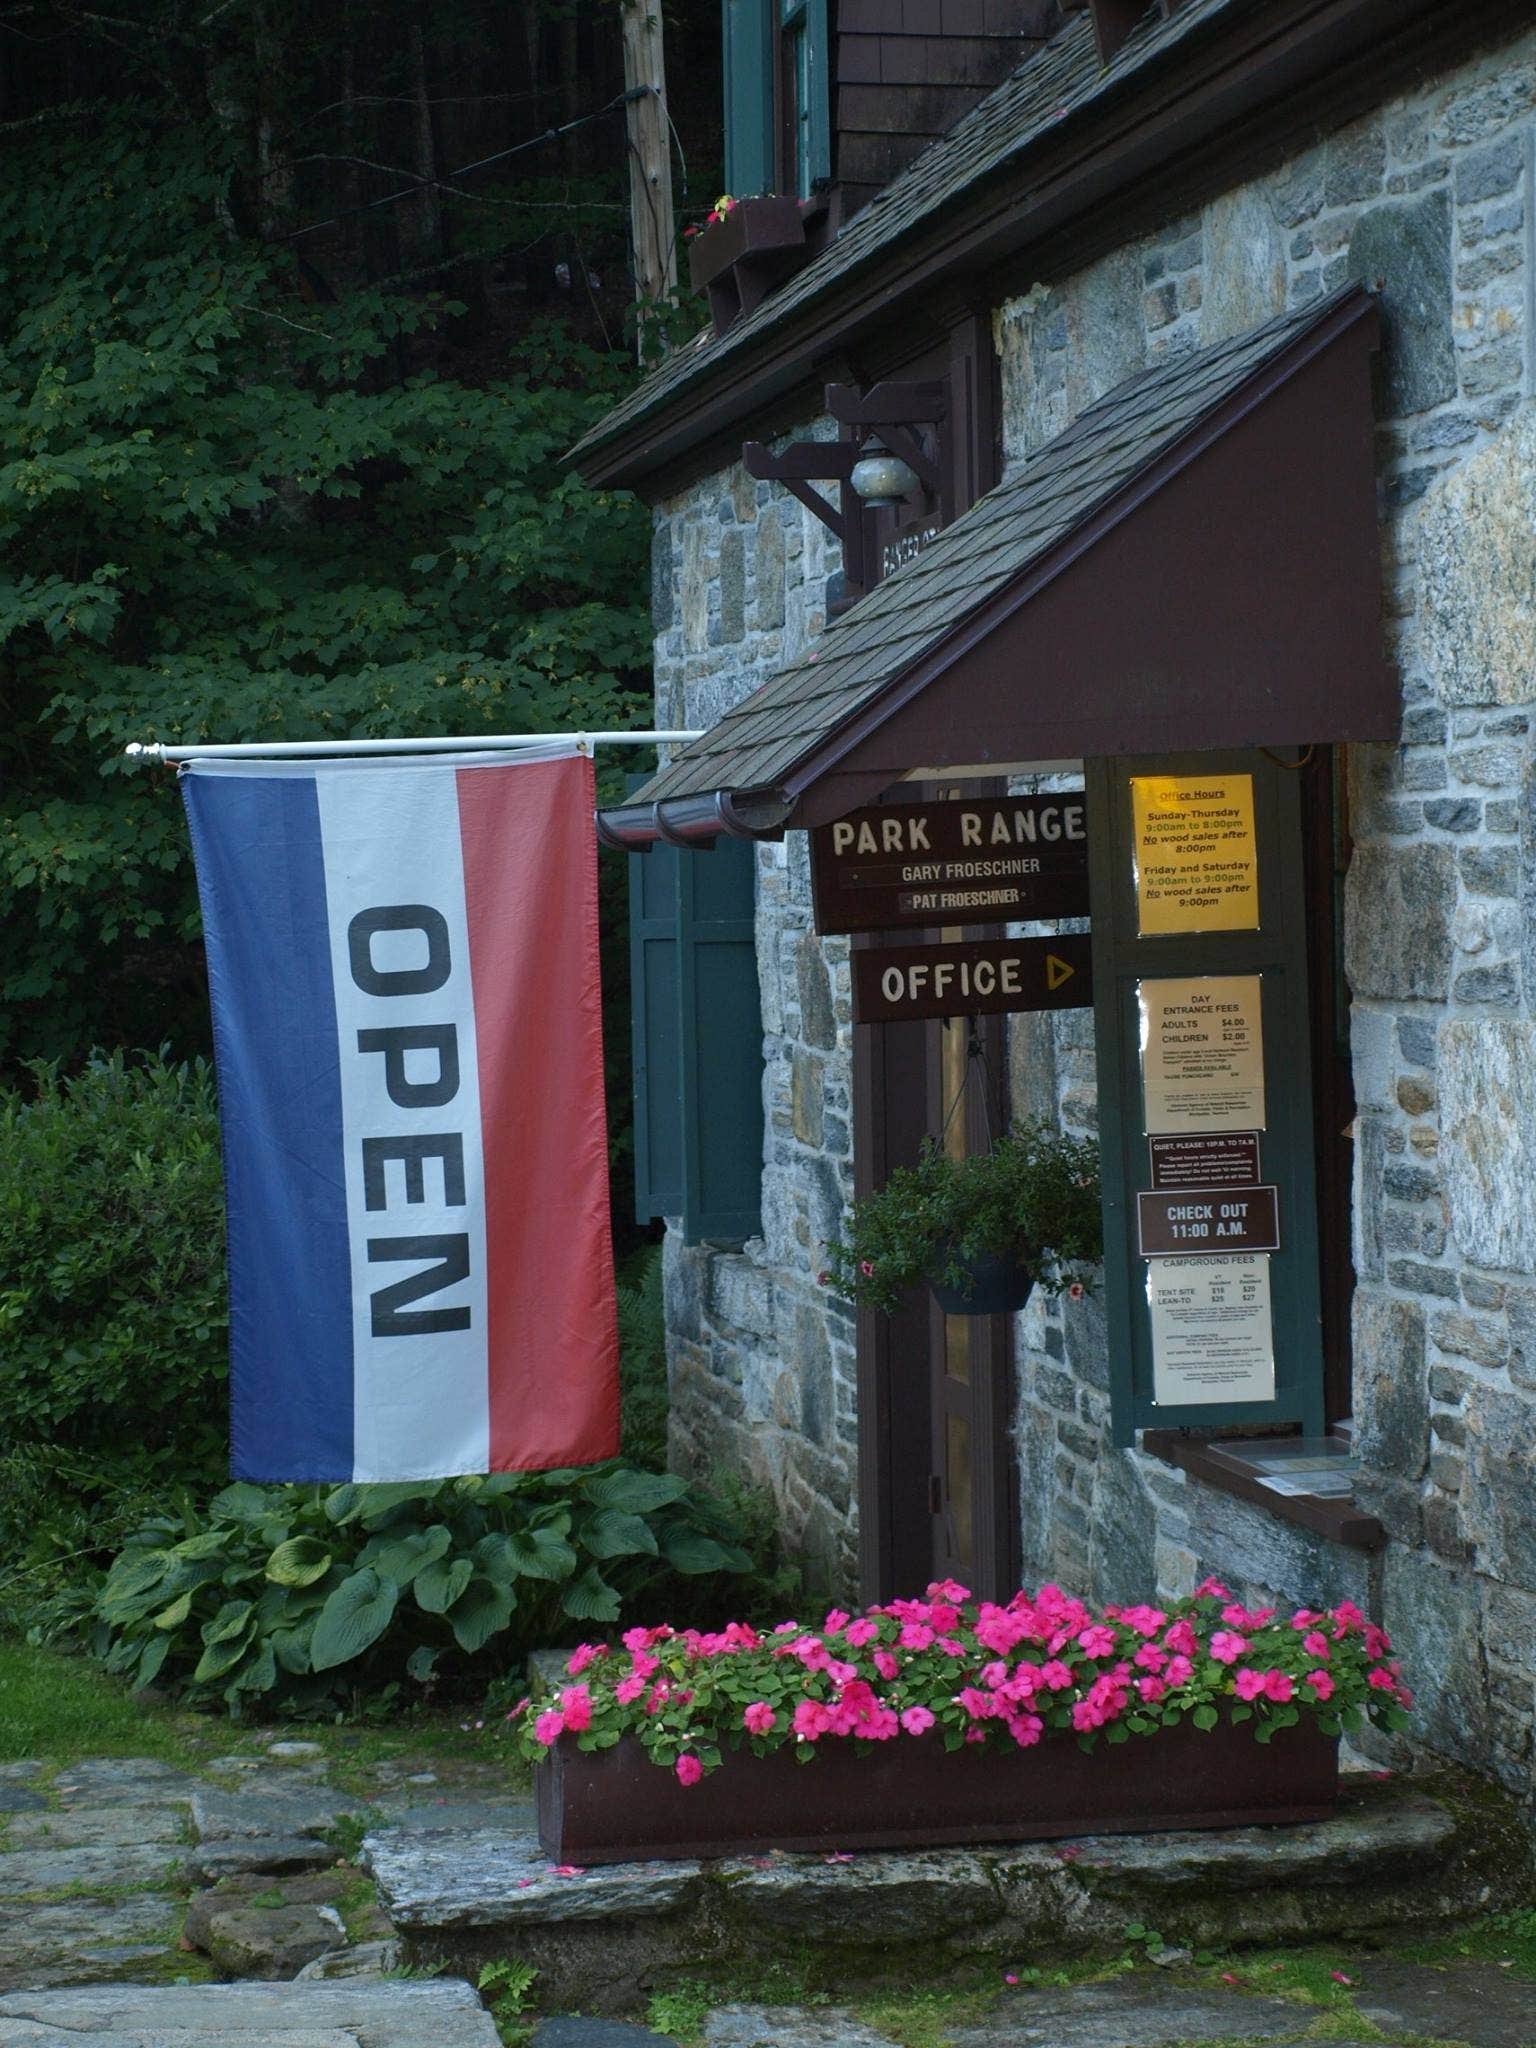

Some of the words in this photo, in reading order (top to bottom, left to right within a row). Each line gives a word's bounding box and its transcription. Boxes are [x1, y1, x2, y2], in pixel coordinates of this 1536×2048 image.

[1160, 791, 1191, 800] Office
[1194, 790, 1225, 799] Hours
[1148, 809, 1240, 821] Sunday-Thursday
[1146, 823, 1185, 832] 9:00am
[1189, 822, 1199, 830] to
[1203, 820, 1243, 830] 8:00pm
[833, 817, 931, 856] PARK
[1143, 836, 1158, 845] No
[1161, 834, 1188, 843] wood
[1192, 832, 1219, 841] sales
[1222, 830, 1248, 839] after
[1176, 844, 1216, 854] 8:00pm
[902, 865, 942, 882] GARY
[946, 858, 1040, 880] FROESCHNER
[1144, 865, 1176, 875] Friday
[1180, 864, 1199, 873] and
[1203, 862, 1250, 871] Saturday
[1147, 877, 1187, 886] 9:00am
[1191, 876, 1201, 884] to
[1205, 874, 1244, 883] 9:00pm
[1146, 889, 1160, 899] No
[1164, 887, 1192, 896] wood
[1195, 885, 1222, 895] sales
[1225, 883, 1251, 893] after
[912, 893, 937, 909] PAT
[941, 888, 1019, 908] FROESCHNER
[1179, 898, 1219, 907] 9:00pm
[882, 958, 1023, 1002] OFFICE
[1191, 995, 1211, 1003] DAY
[1163, 1005, 1214, 1015] ENTRANCE
[1216, 1004, 1240, 1013] FEES
[1161, 1020, 1198, 1029] ADULTS
[1222, 1018, 1245, 1027] $4.00
[1162, 1034, 1209, 1043] CHILDREN
[1222, 1032, 1245, 1041] $2.00
[348, 904, 471, 1338] OPEN
[1167, 1205, 1213, 1220] CHECK
[1220, 1203, 1248, 1218] OUT
[1171, 1223, 1209, 1238] 11:00
[1216, 1221, 1247, 1236] A.M.
[1162, 1256, 1229, 1267] CAMPGROUND
[1231, 1255, 1255, 1264] FEES
[1158, 1297, 1191, 1305] LEAN-TO
